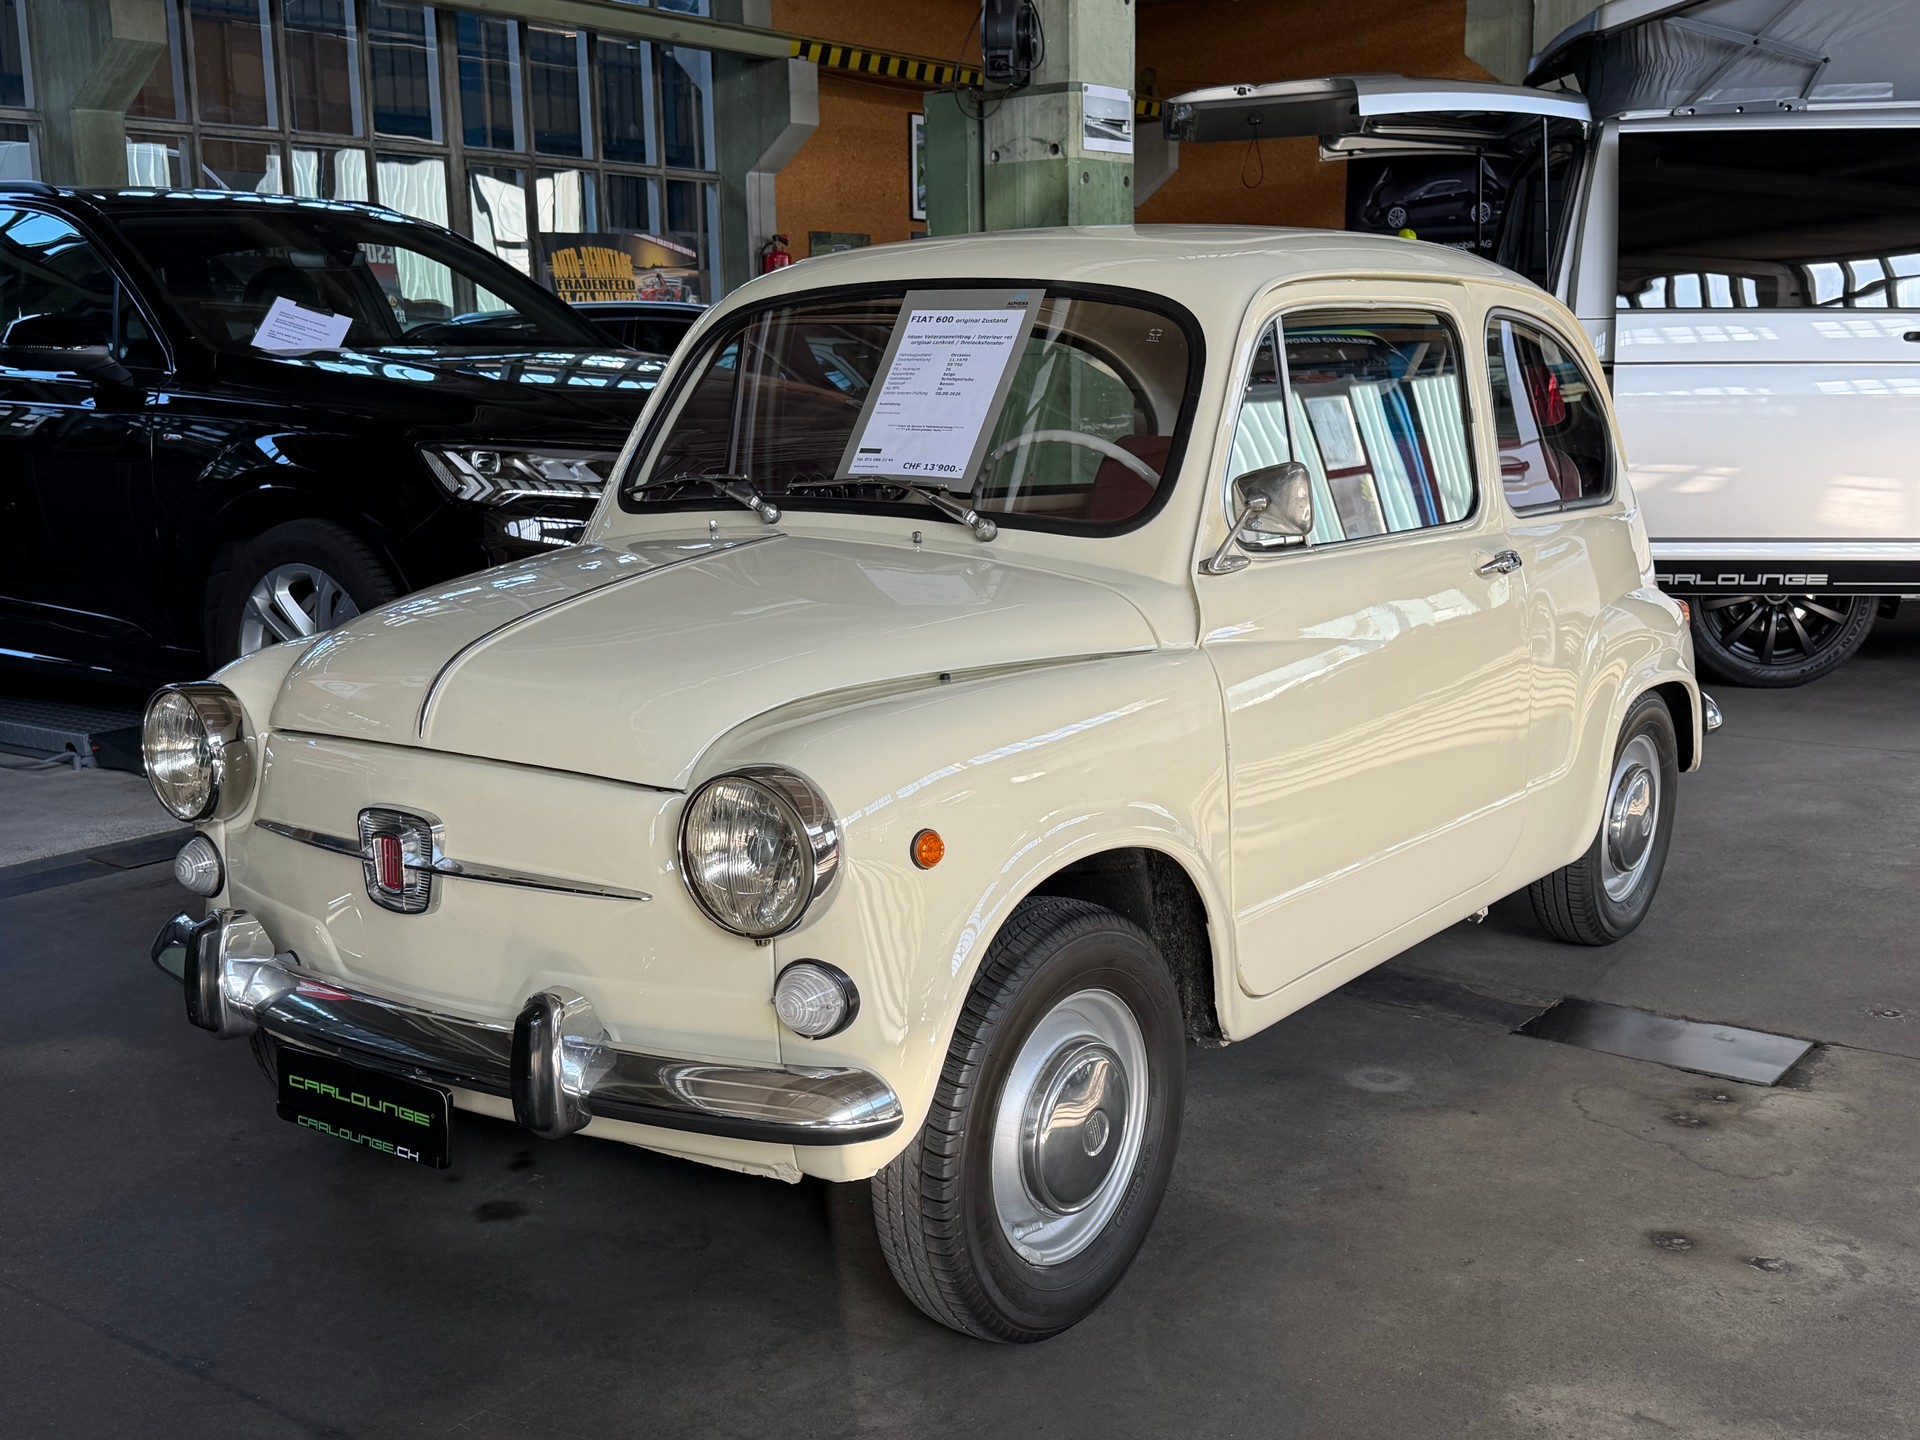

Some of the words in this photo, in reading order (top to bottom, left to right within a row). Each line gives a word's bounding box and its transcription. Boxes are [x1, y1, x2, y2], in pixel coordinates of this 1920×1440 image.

[557, 279, 636, 290] FRAUENFELD
[910, 315, 934, 323] FIAT
[935, 315, 954, 323] 600
[1284, 337, 1320, 345] WORLD
[903, 462, 921, 470] CHF
[923, 463, 962, 472] 13'900.-
[1655, 573, 1829, 585] ARLOUNGE
[297, 1115, 419, 1162] CARLOUNGE.CH
